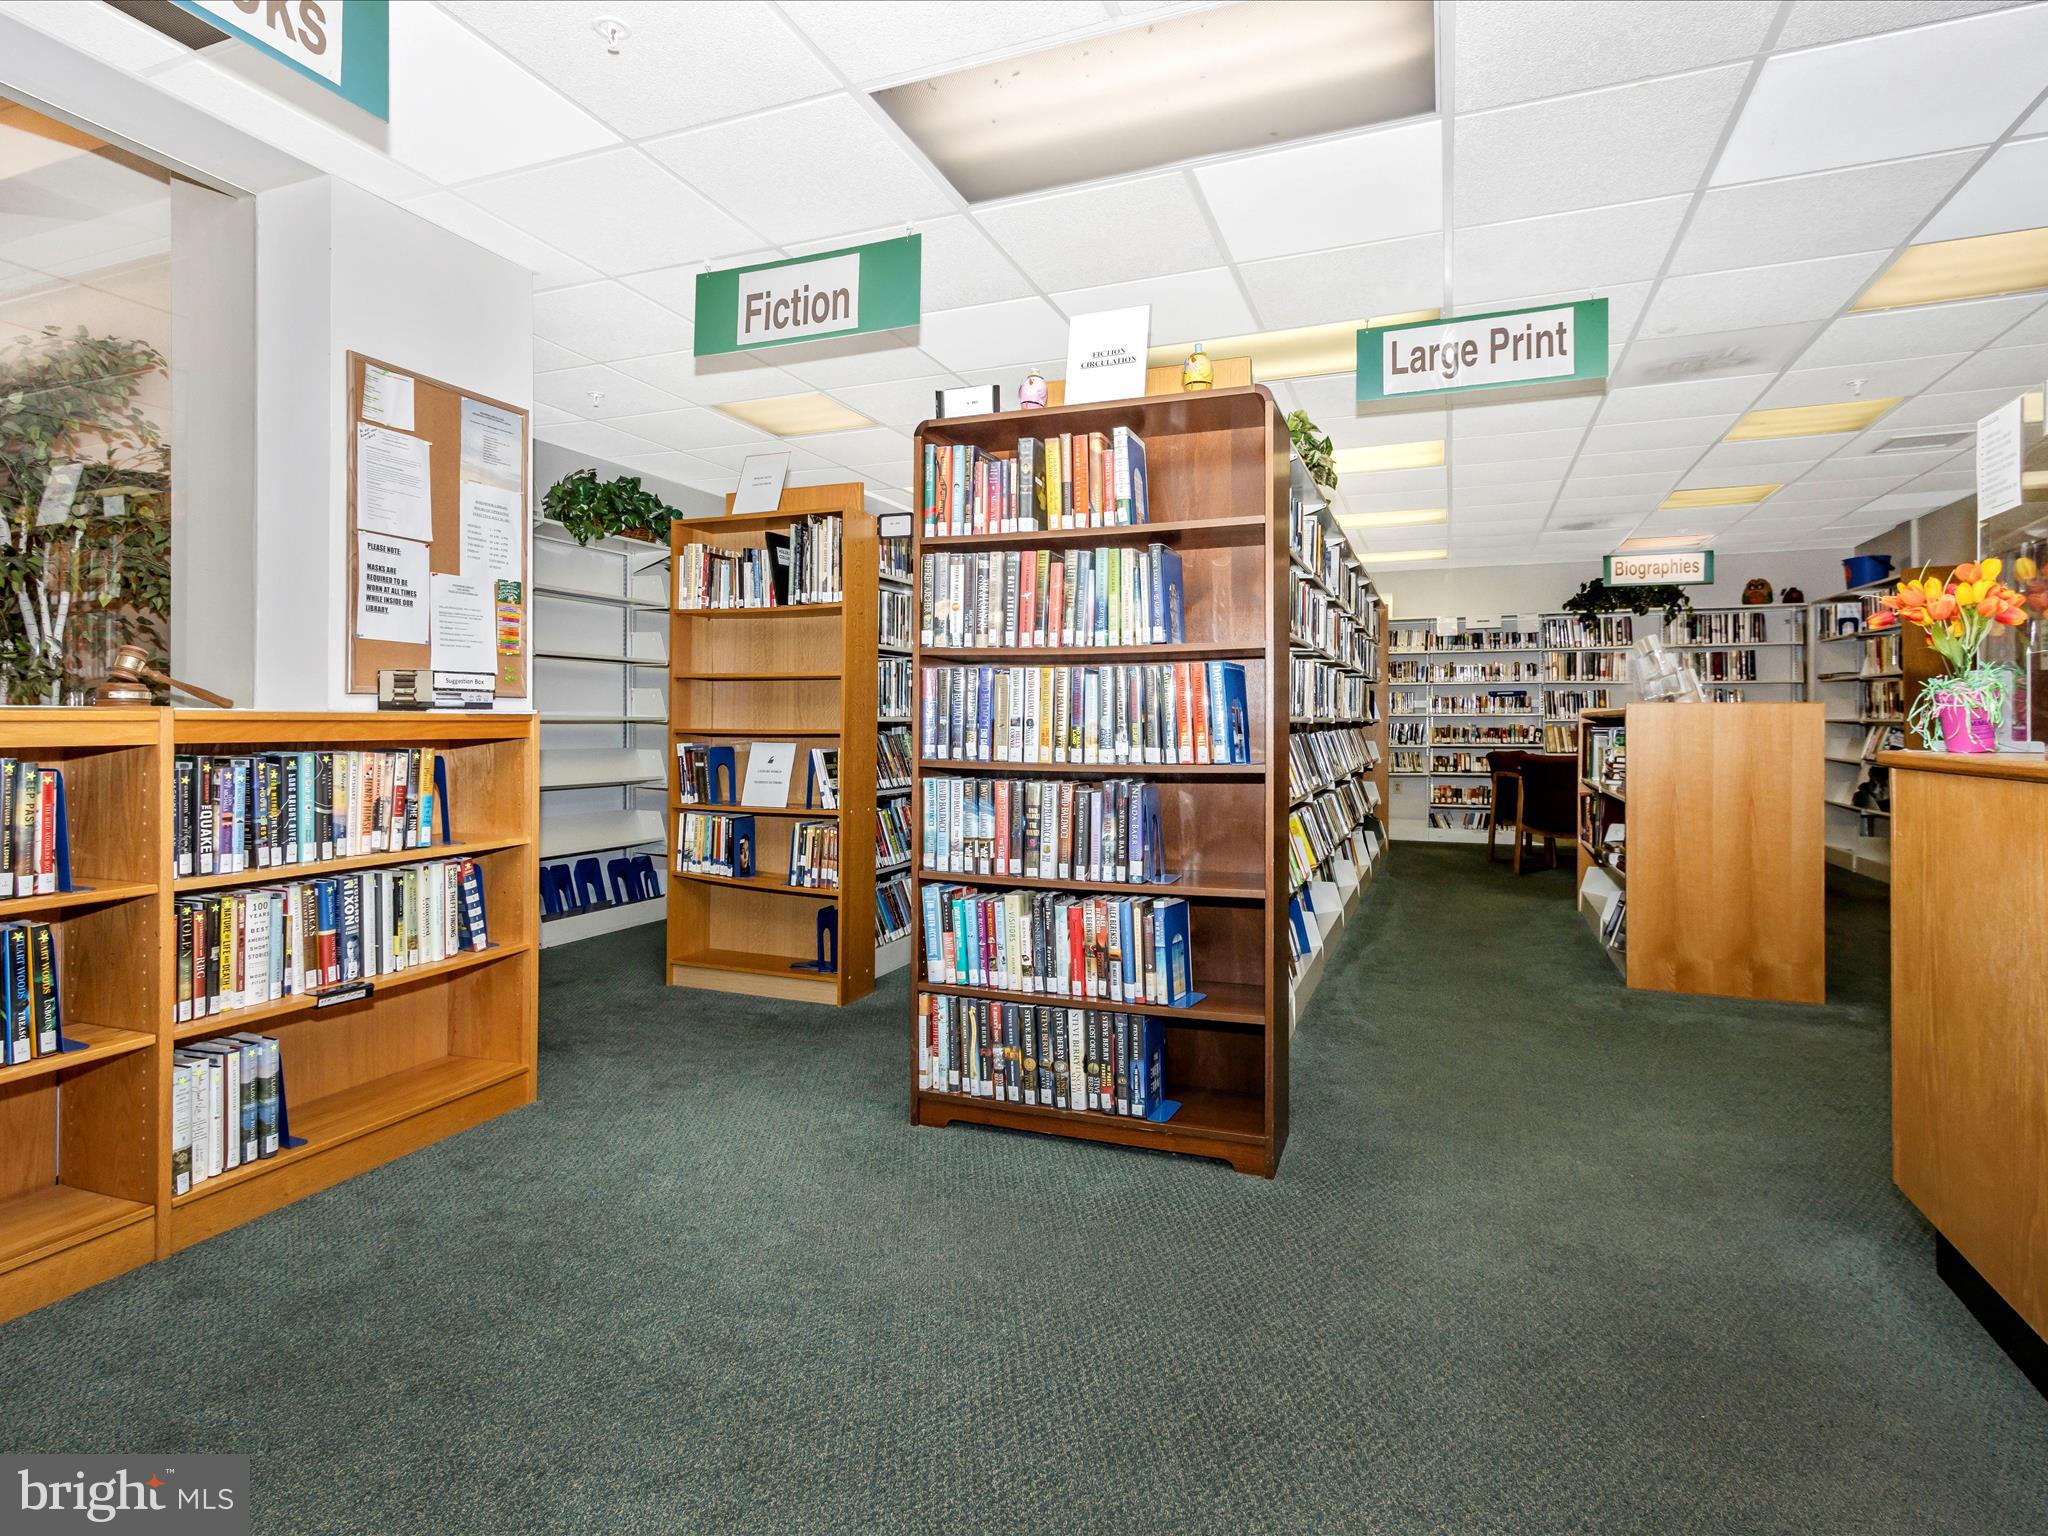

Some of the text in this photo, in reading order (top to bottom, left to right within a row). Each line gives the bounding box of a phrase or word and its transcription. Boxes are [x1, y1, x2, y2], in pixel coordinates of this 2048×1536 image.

[744, 284, 850, 334] Fiction
[1080, 356, 1137, 369] CIRCULATION
[1092, 348, 1126, 358] FICTION
[1391, 321, 1568, 380] Large Print
[367, 542, 402, 556] PLEASE NOTE:
[366, 563, 397, 575] MASKS ARE
[366, 573, 393, 584] REQUIRED
[393, 577, 401, 585] TO
[1614, 559, 1700, 580] Biographies
[366, 583, 383, 592] WORN
[384, 586, 391, 594] AT
[400, 589, 417, 597] TIMES
[366, 594, 414, 607] WHILE INSIDE OUR
[1006, 596, 1014, 632] ATKINSON
[445, 678, 474, 686] Suggestion
[1056, 671, 1066, 732] DAVID BALDACCI
[938, 781, 946, 800] DAVID
[25, 803, 35, 829] PAST
[288, 774, 296, 844] LONG BRIGHT RIVE
[362, 804, 372, 835] HIMSEL
[410, 804, 418, 832] THE INN
[1043, 785, 1052, 844] DAVID BALDACCI
[1060, 786, 1071, 839] DAVID BALDACCI
[252, 902, 269, 912] 100
[308, 894, 316, 936] MERICA'S
[344, 880, 354, 926] NIXON
[182, 917, 192, 958] TOLEN
[222, 940, 231, 955] LIFE
[40, 962, 51, 994] WOODS
[197, 957, 206, 980] RBG
[222, 964, 231, 986] DEATH
[16, 966, 26, 1000] WOODS
[18, 1010, 27, 1040] TREASO
[1072, 1012, 1081, 1065] STEVE BERRY
